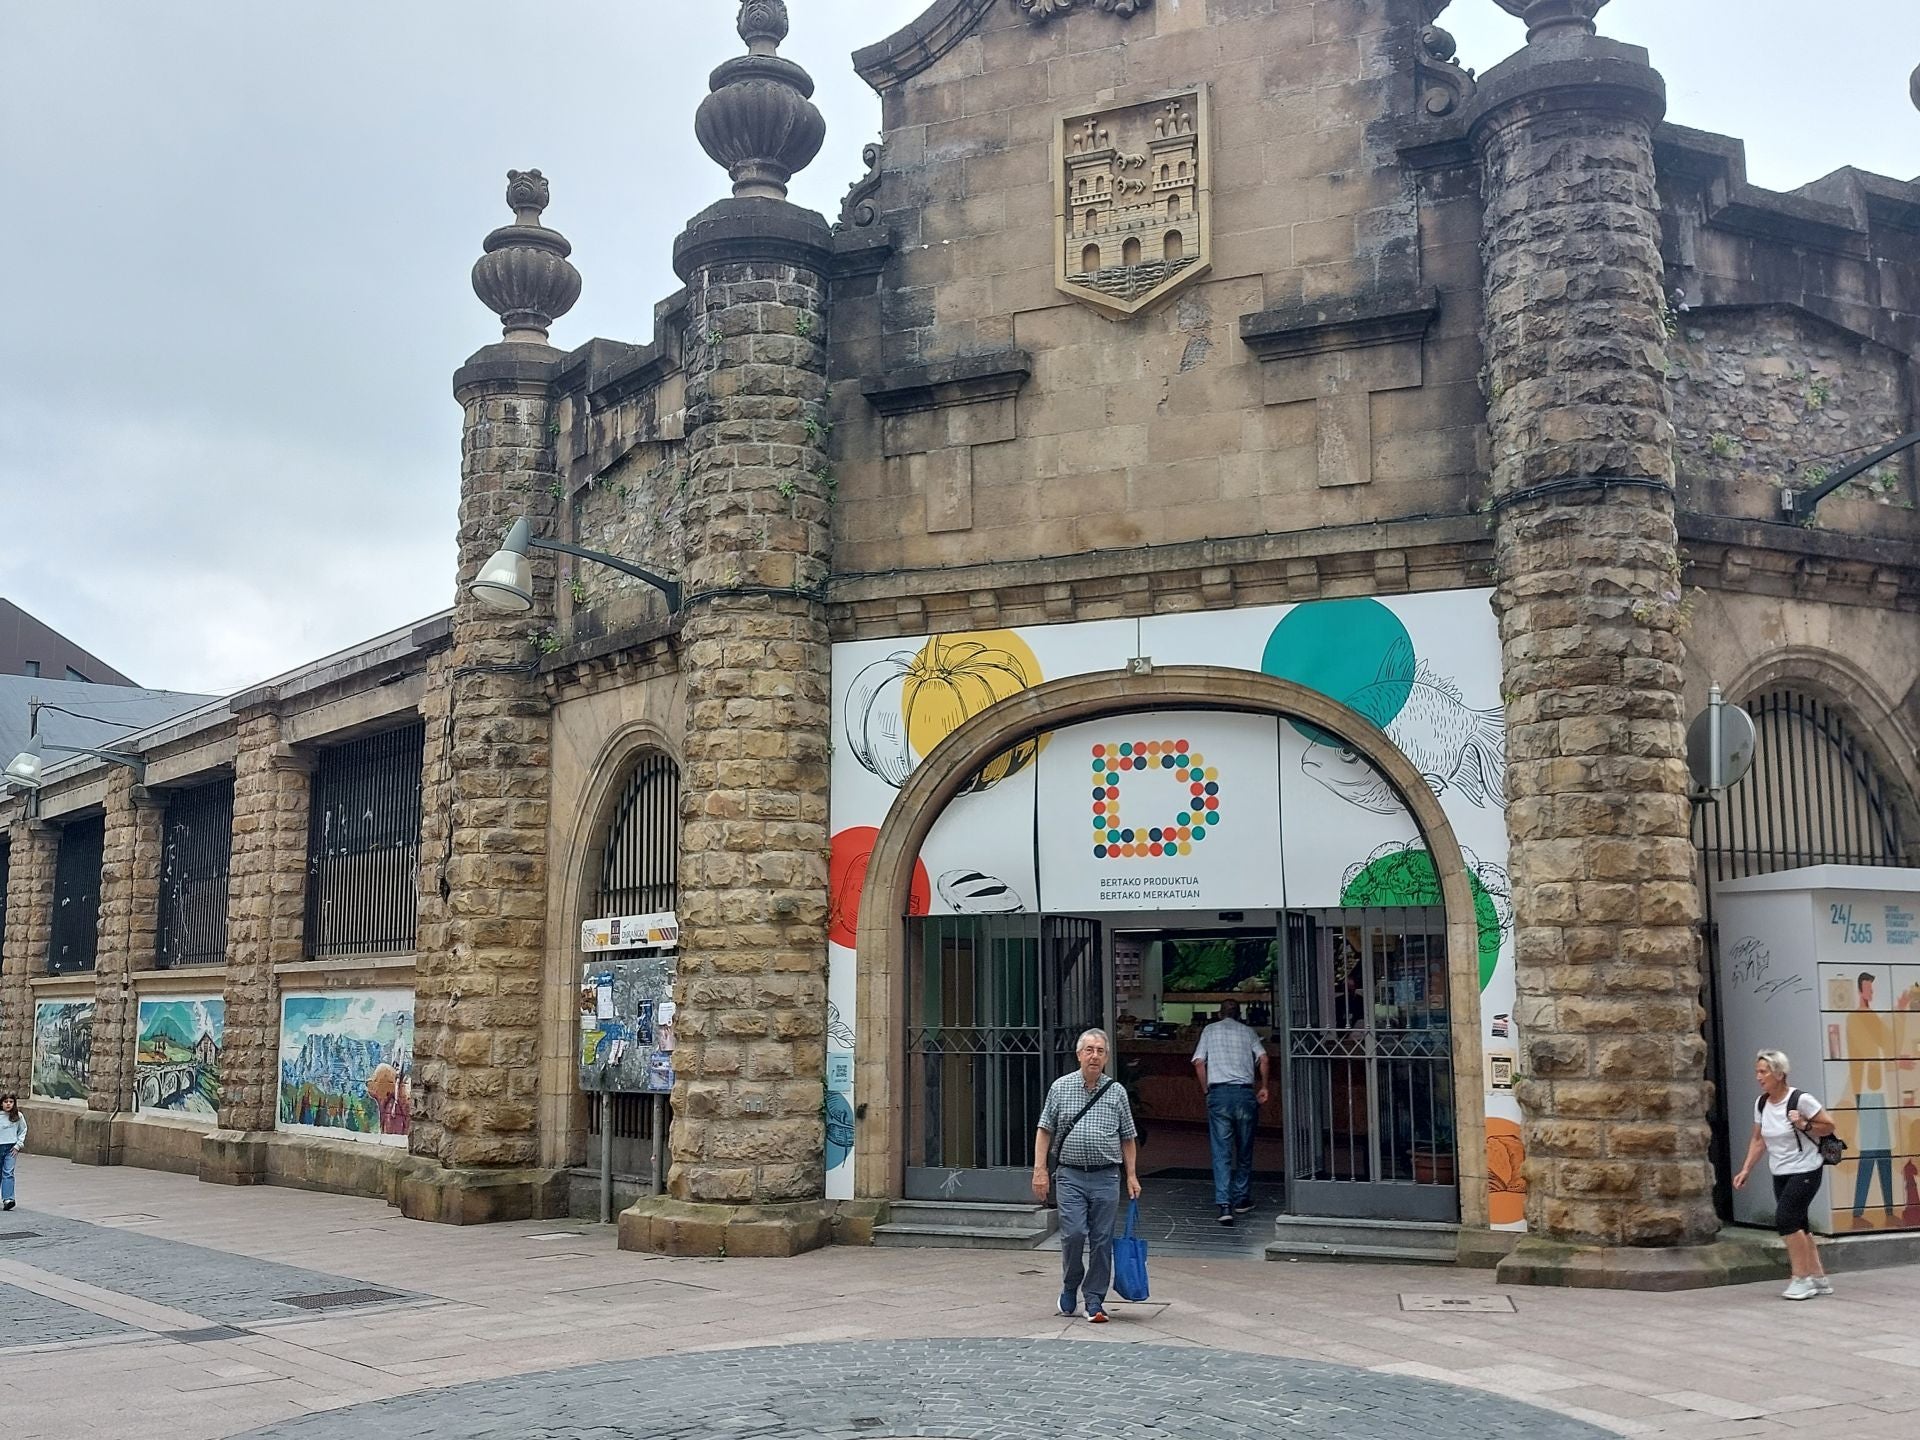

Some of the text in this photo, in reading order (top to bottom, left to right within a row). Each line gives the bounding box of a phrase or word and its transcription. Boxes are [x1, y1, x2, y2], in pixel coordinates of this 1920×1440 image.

[1134, 658, 1143, 673] 2
[1100, 876, 1199, 887] BERTAKO PRODUKTUA
[1100, 889, 1200, 900] BERTAKO MERKATUAN
